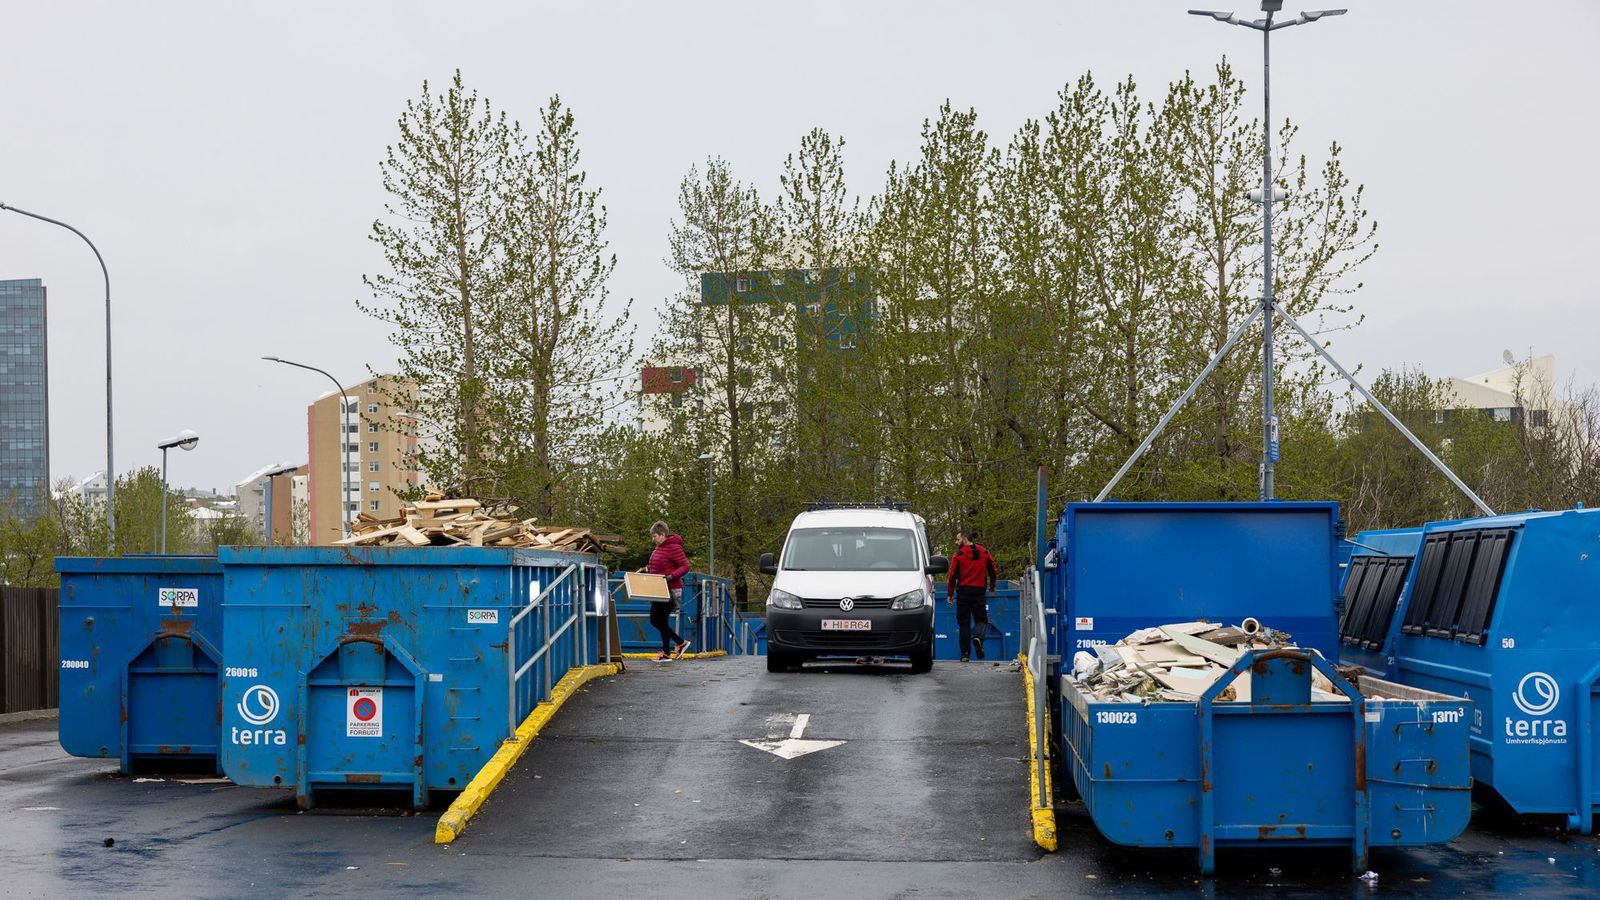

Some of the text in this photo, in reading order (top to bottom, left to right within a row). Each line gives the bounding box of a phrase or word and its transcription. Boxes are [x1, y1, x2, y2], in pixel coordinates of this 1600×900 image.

[161, 591, 196, 601] SORPA
[469, 611, 497, 620] SORPA
[850, 621, 870, 630] R64
[1502, 638, 1515, 649] 50
[61, 659, 89, 669] 280040
[225, 666, 258, 678] 260016
[1096, 711, 1137, 725] 130023
[1505, 716, 1567, 737] terra
[231, 726, 287, 745] terra
